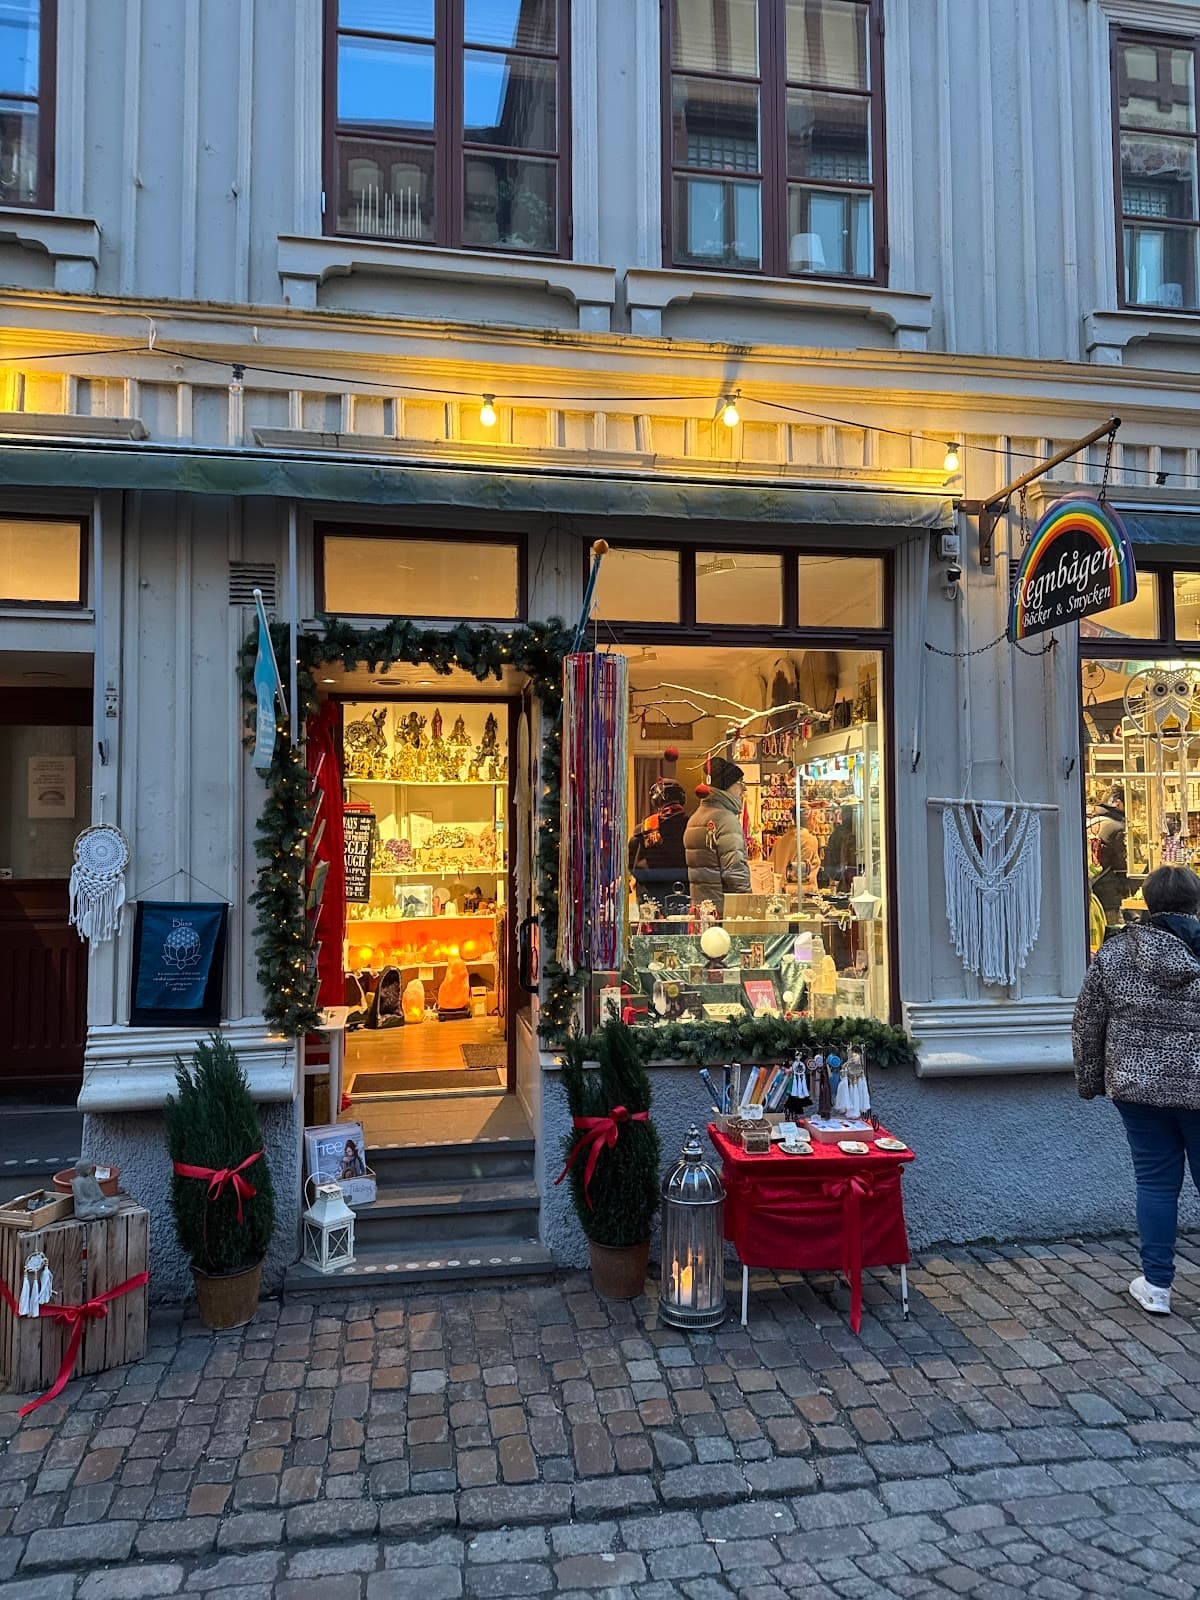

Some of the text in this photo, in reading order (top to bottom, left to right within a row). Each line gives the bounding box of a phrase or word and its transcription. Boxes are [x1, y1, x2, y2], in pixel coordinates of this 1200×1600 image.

[1013, 539, 1127, 610] Regnbågens
[1022, 583, 1112, 628] Böcker & Smycken
